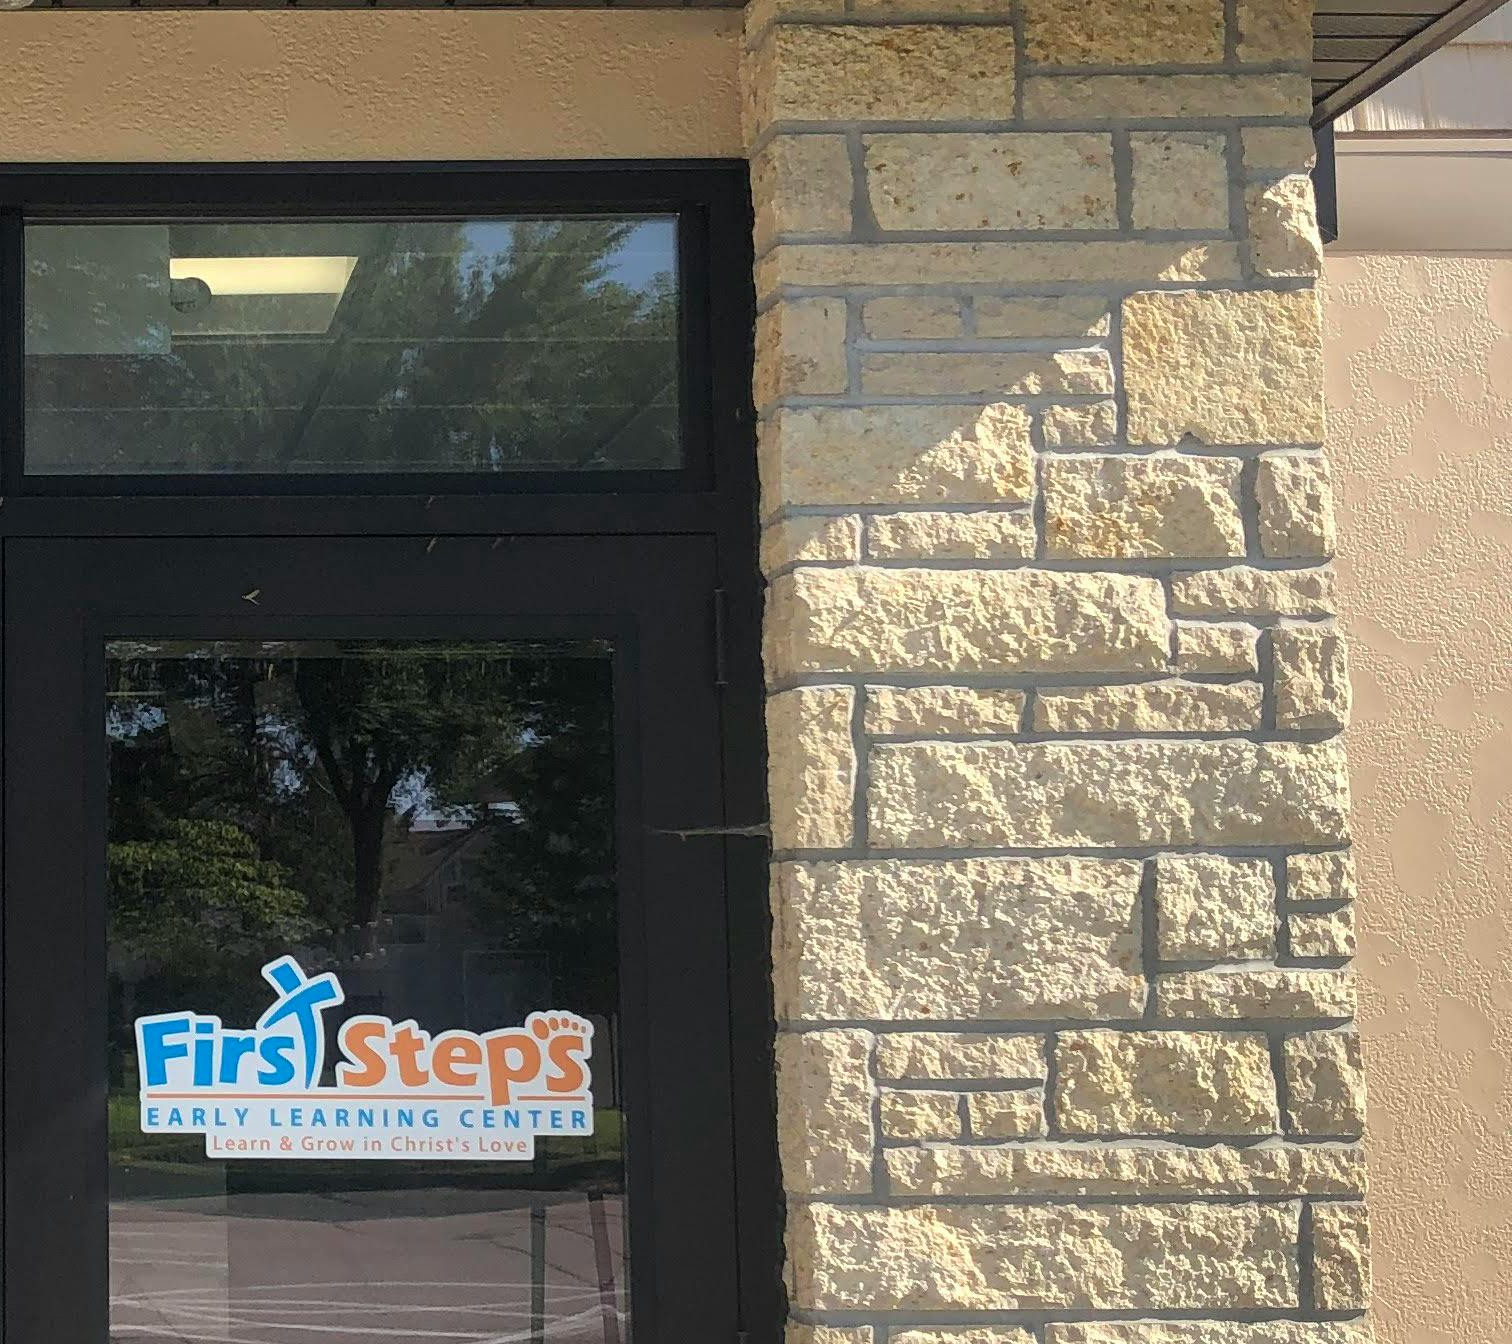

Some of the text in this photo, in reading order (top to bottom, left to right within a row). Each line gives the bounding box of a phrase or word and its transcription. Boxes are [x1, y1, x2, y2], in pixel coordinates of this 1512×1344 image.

[140, 961, 339, 1090] First
[146, 1106, 587, 1130] EARLY LEARNING CENTER
[213, 1136, 527, 1153] Learn & Grow in Christ's Love
